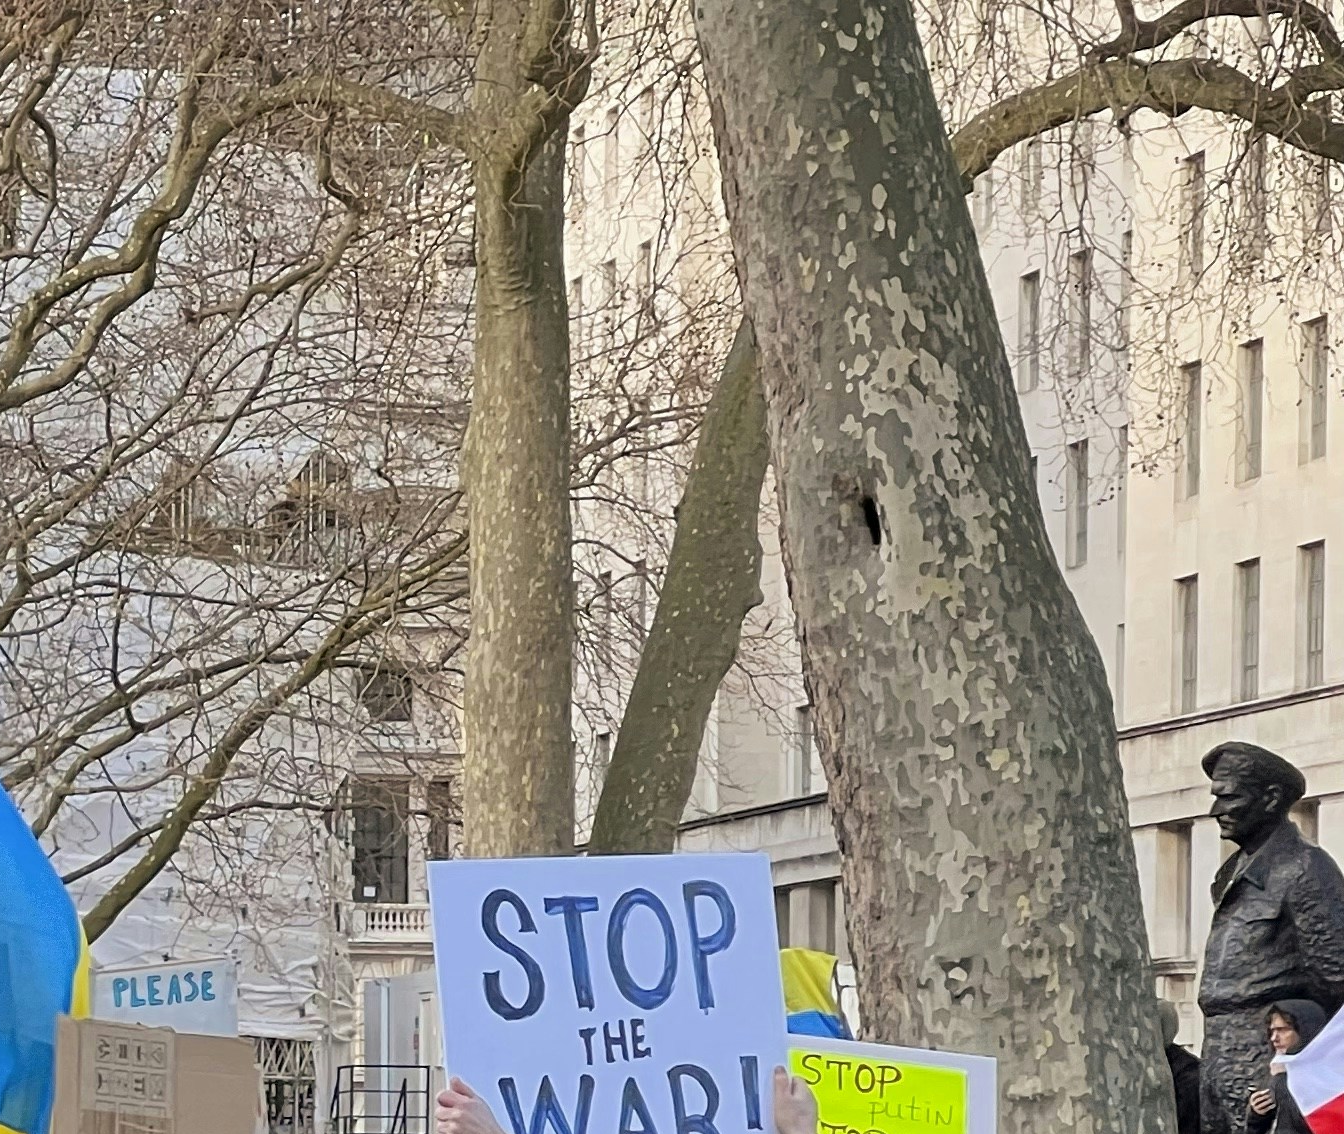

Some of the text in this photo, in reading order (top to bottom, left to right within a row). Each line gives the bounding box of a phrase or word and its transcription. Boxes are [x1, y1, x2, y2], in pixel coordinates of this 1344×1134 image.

[481, 879, 736, 1021] STOP
[113, 971, 216, 1008] PLEASE
[579, 1018, 652, 1066] THE
[801, 1054, 902, 1099] STOP
